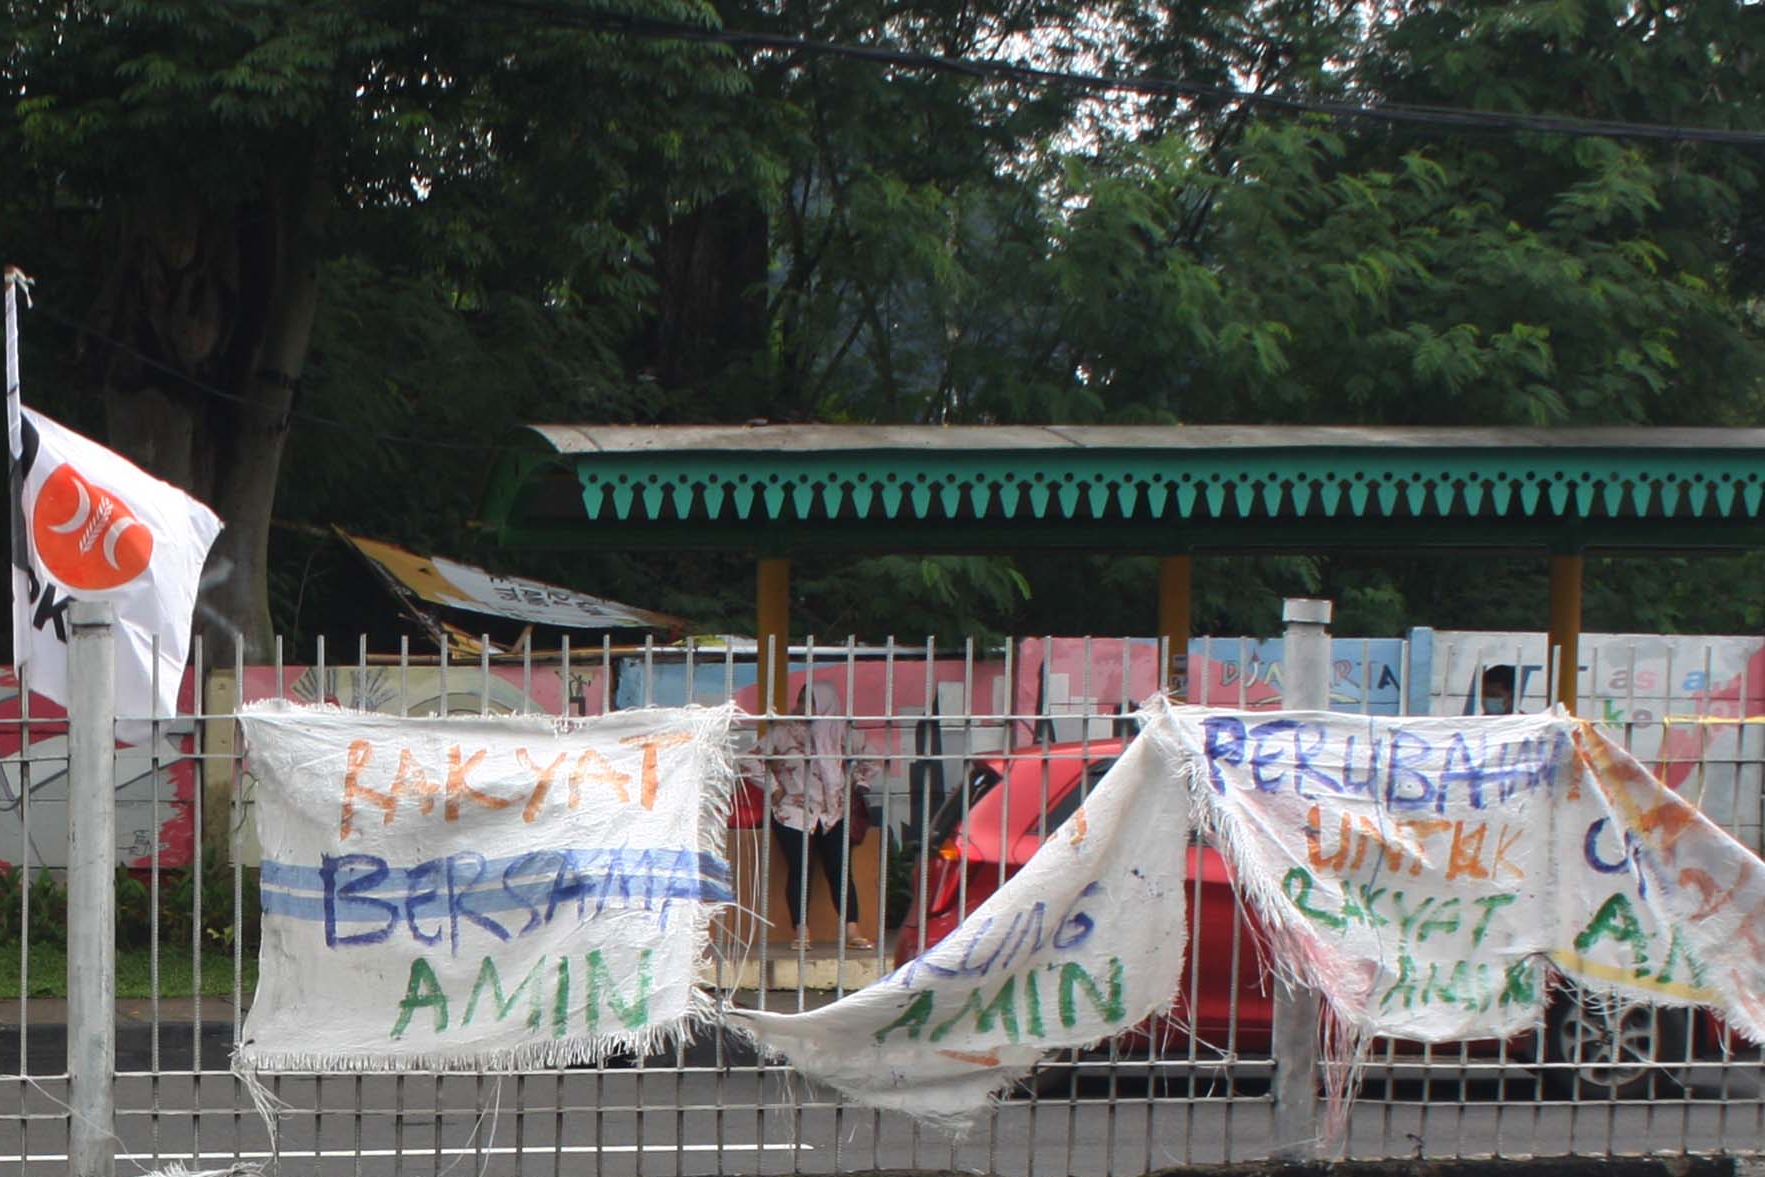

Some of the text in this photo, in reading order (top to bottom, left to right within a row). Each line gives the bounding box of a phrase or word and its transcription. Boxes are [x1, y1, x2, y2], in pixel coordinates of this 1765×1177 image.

[340, 731, 694, 840] RAKYAT
[1306, 804, 1526, 881] UNTUK
[319, 840, 702, 958] BERSAMA
[1283, 866, 1517, 950] RAKYAT
[390, 949, 654, 1040] AMIN
[872, 956, 1126, 1044] AMIN
